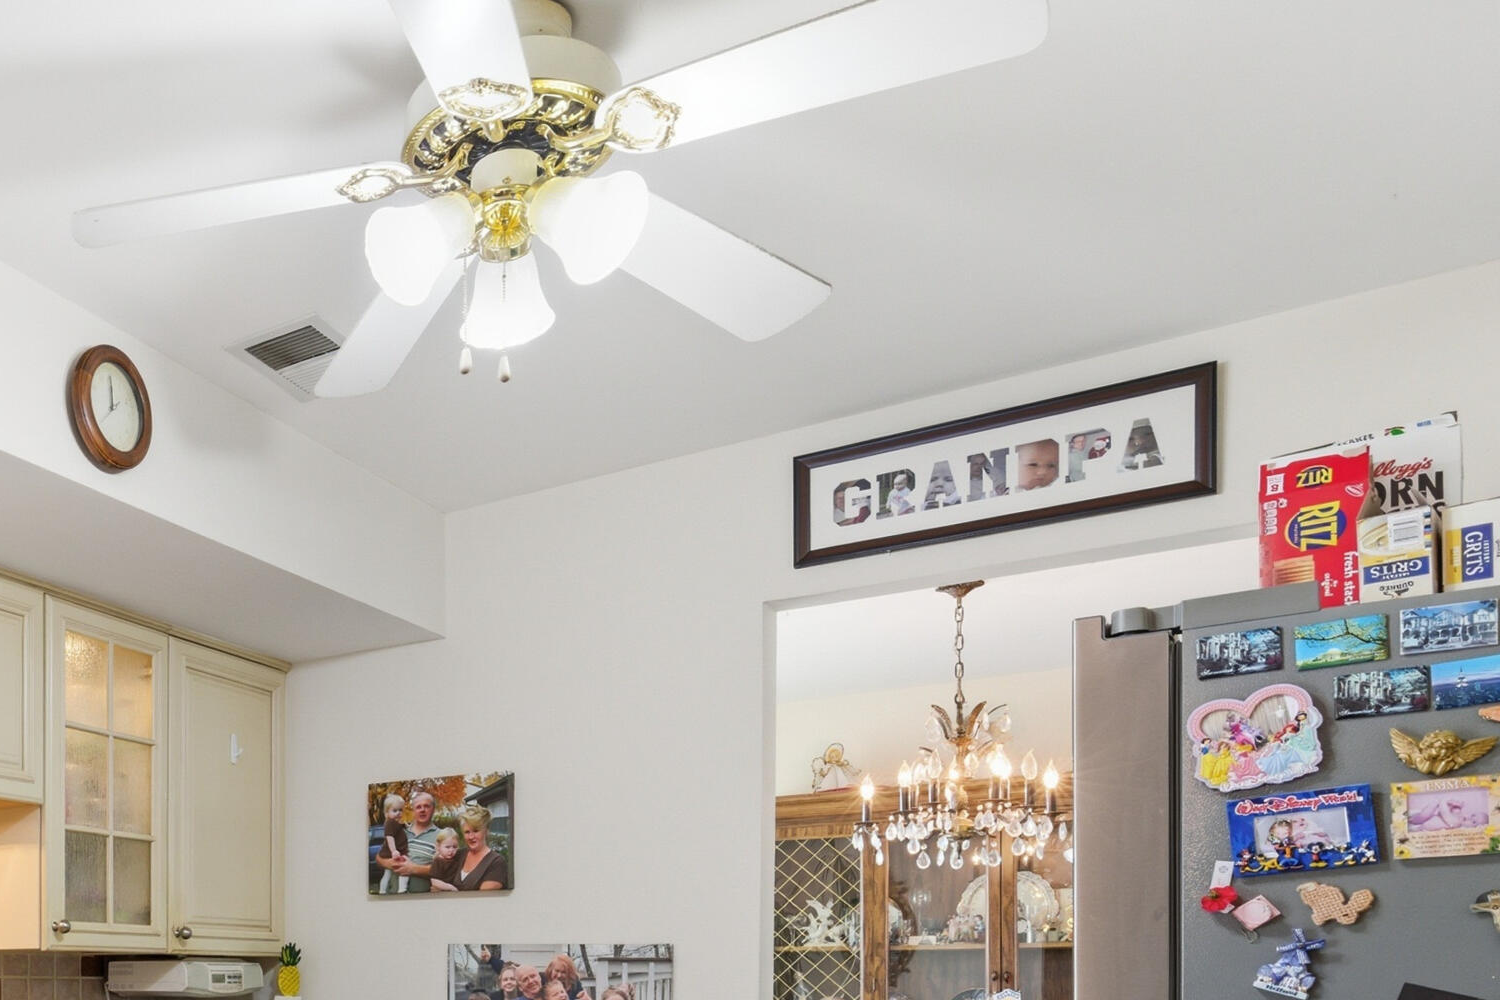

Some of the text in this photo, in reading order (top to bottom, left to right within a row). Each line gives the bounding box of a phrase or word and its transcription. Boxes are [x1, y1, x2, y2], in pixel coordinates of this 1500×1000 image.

[833, 418, 1165, 527] GRANDPA
[1297, 466, 1333, 489] RITZ
[1373, 457, 1433, 480] llogg's
[1374, 471, 1444, 508] ORN
[1300, 500, 1341, 552] RITZ
[1370, 559, 1423, 578] GRITS
[1464, 531, 1484, 577] GRITS
